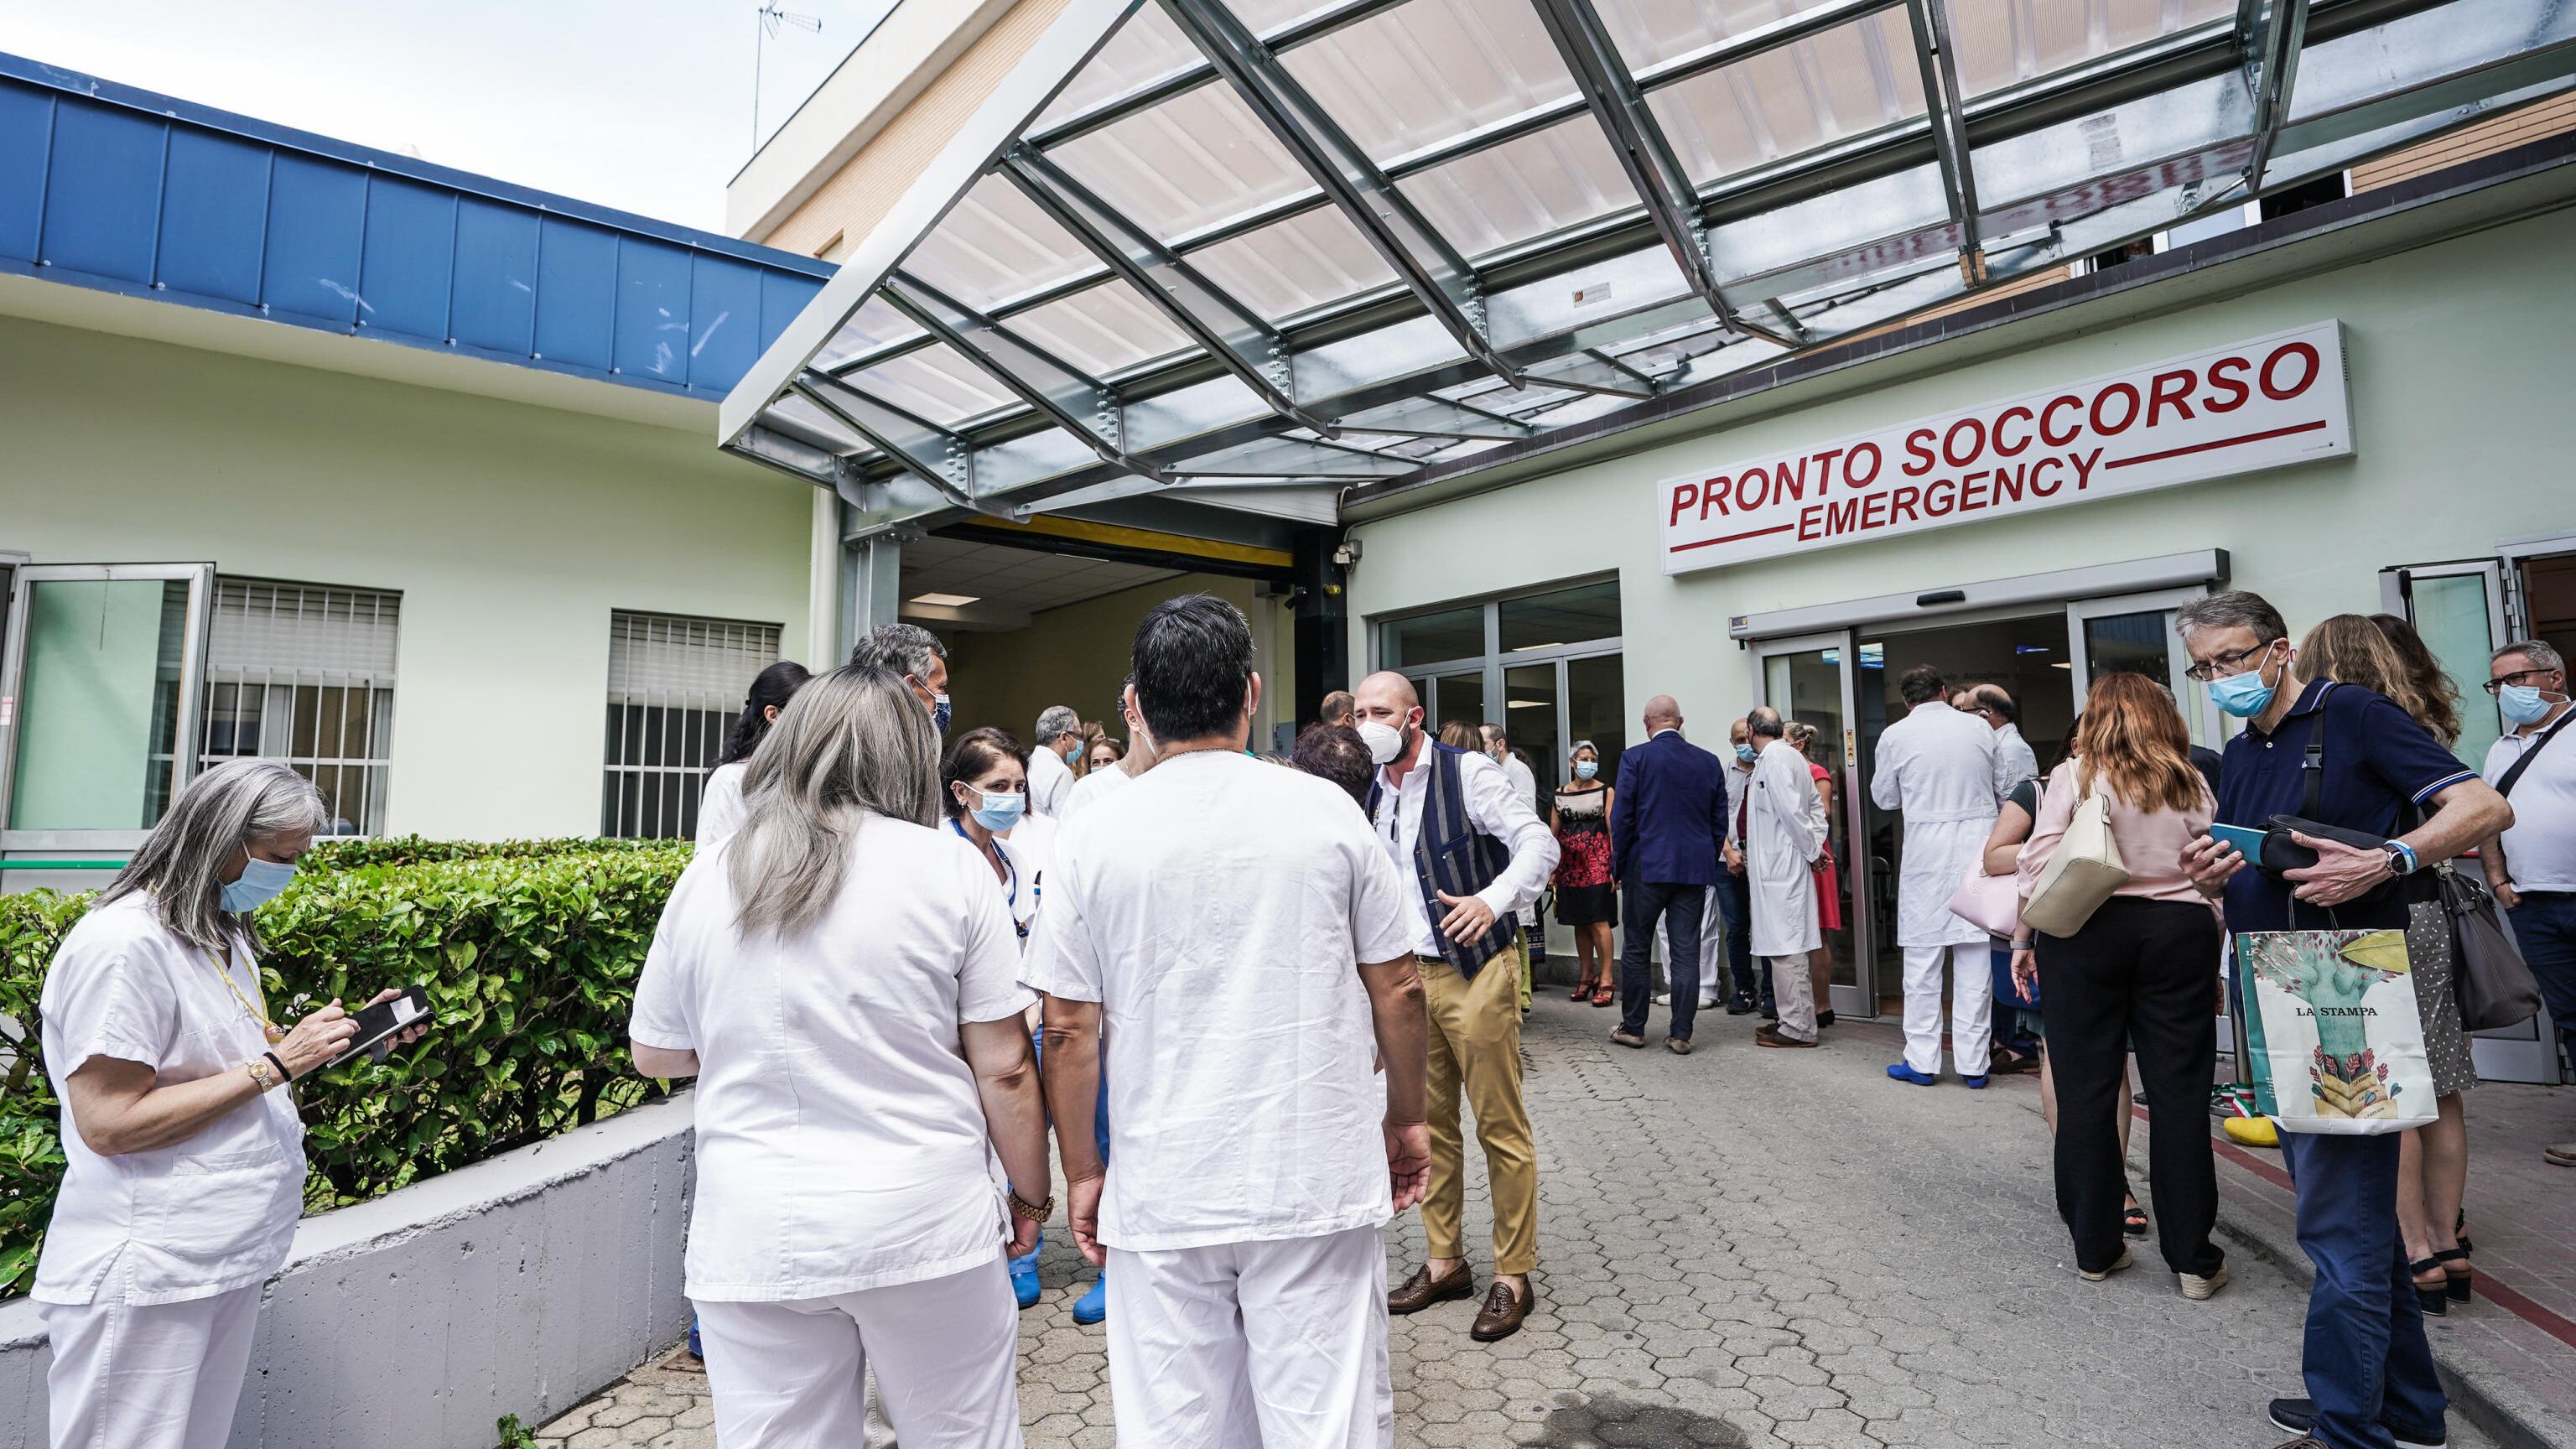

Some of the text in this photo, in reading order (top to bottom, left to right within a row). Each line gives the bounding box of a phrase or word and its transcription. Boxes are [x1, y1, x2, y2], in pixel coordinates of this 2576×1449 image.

[1670, 343, 2320, 527] PRONTO SOCCORSO
[1798, 449, 2105, 543] EMERGENCY
[2296, 1007, 2378, 1016] LA STAMPA
